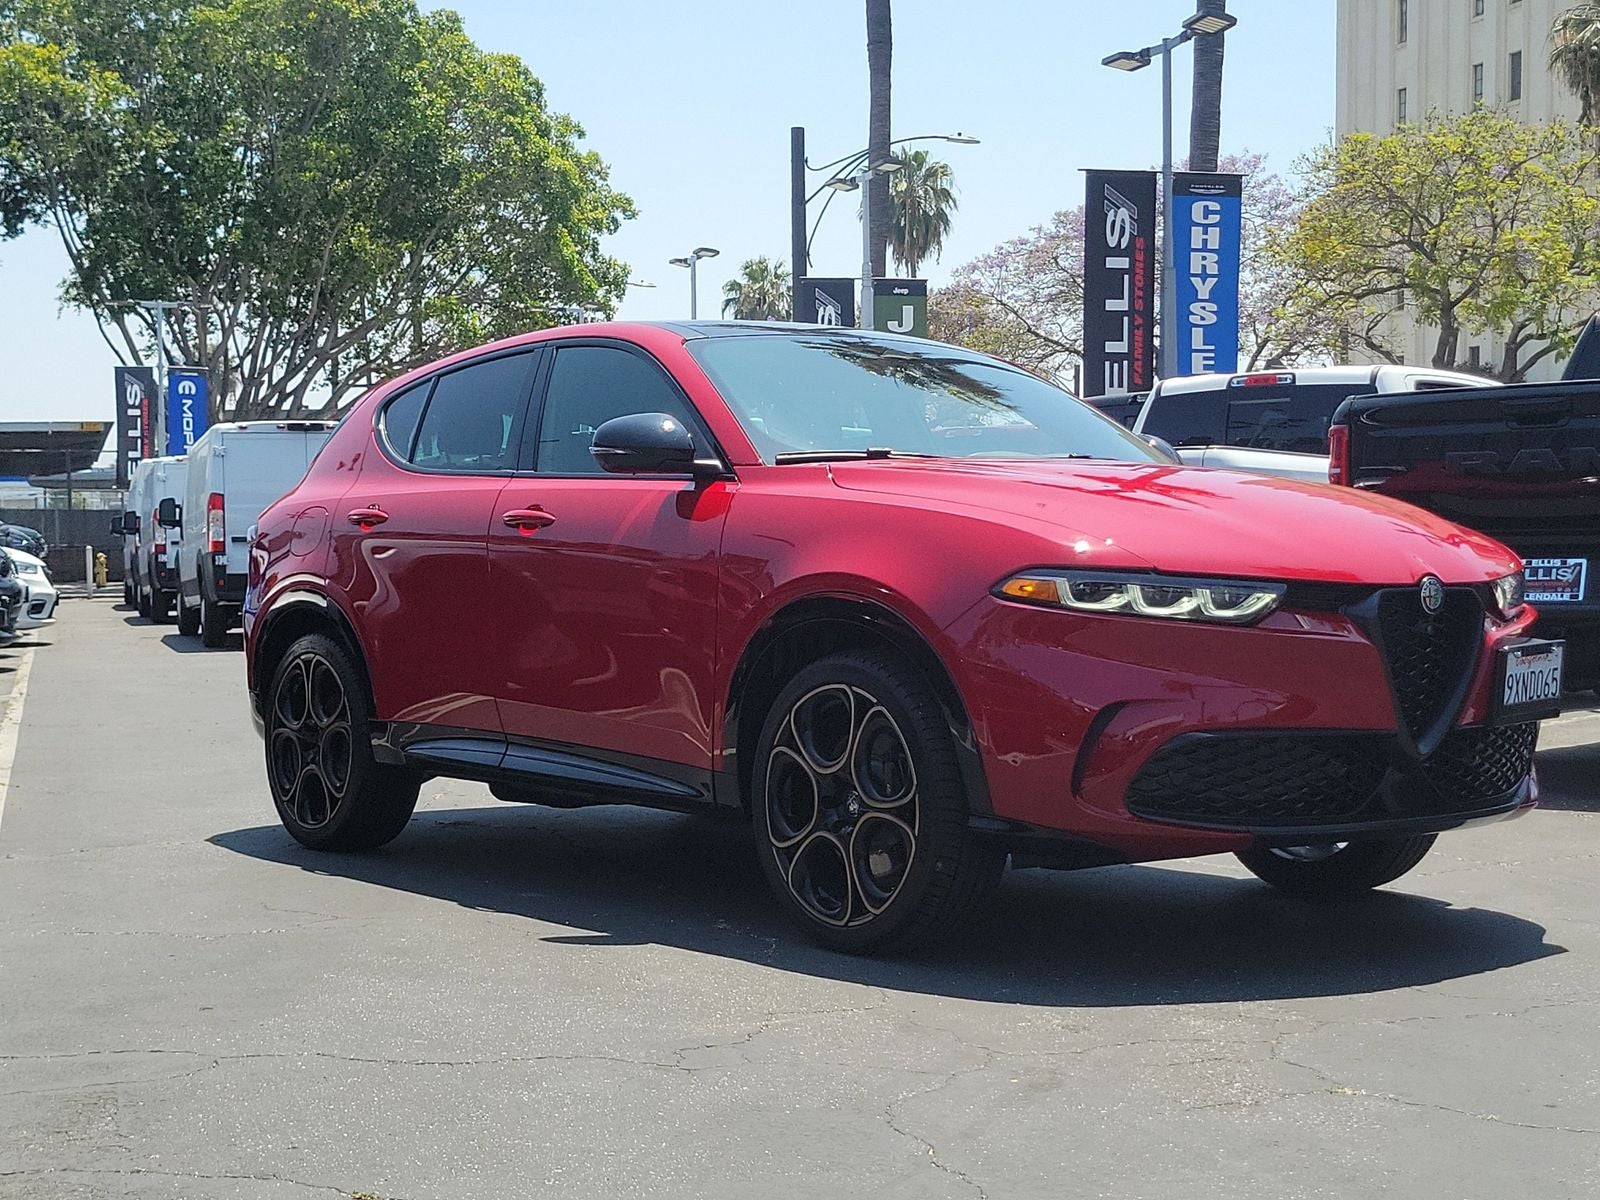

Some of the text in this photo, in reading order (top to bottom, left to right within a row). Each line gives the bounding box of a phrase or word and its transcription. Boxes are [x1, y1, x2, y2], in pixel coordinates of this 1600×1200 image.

[1104, 207, 1130, 396] ELLIS
[182, 399, 195, 451] MOP
[1522, 567, 1574, 580] LLIS
[1532, 559, 1561, 567] ELLIS
[1506, 667, 1559, 704] 9XND065
